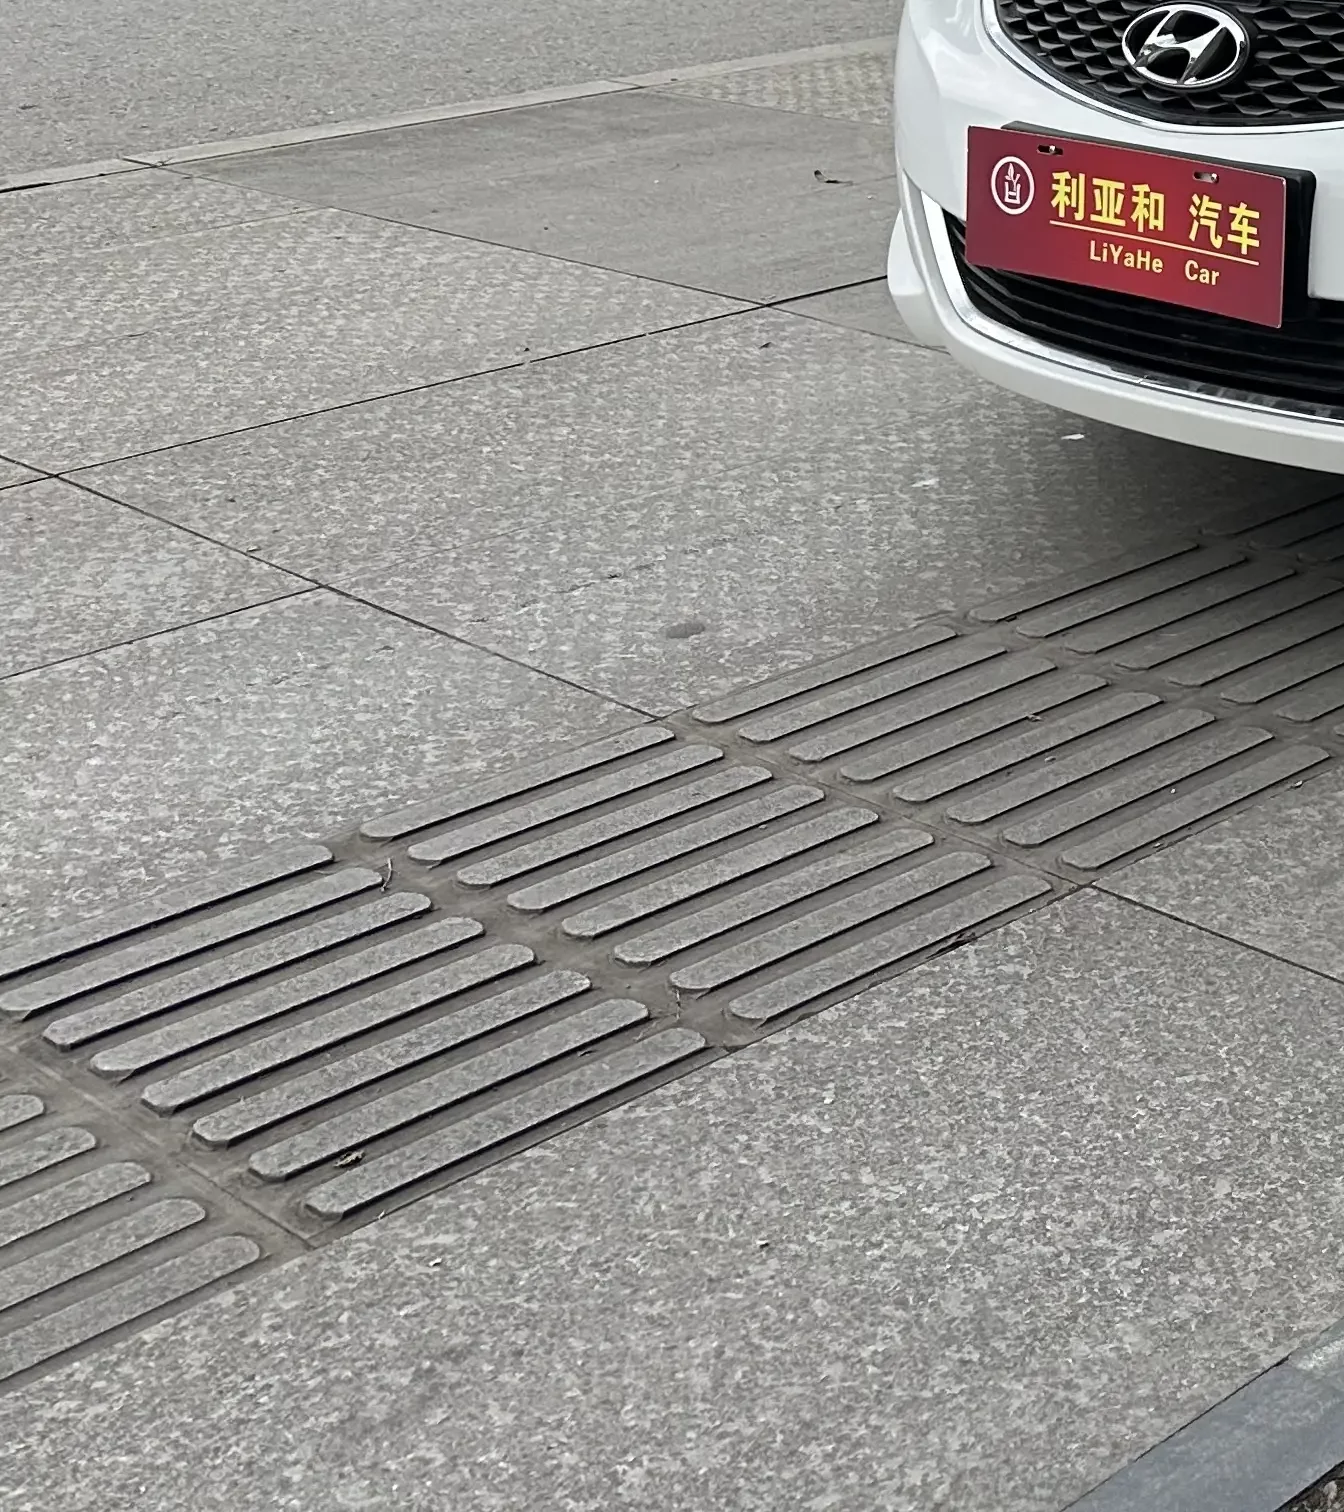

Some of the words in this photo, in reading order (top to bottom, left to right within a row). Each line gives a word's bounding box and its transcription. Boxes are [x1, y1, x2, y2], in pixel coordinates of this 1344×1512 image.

[1051, 171, 1165, 233] 利亚和
[1189, 193, 1260, 256] 汽车
[1089, 240, 1164, 274] LiYaHe
[1184, 260, 1220, 286] Car
